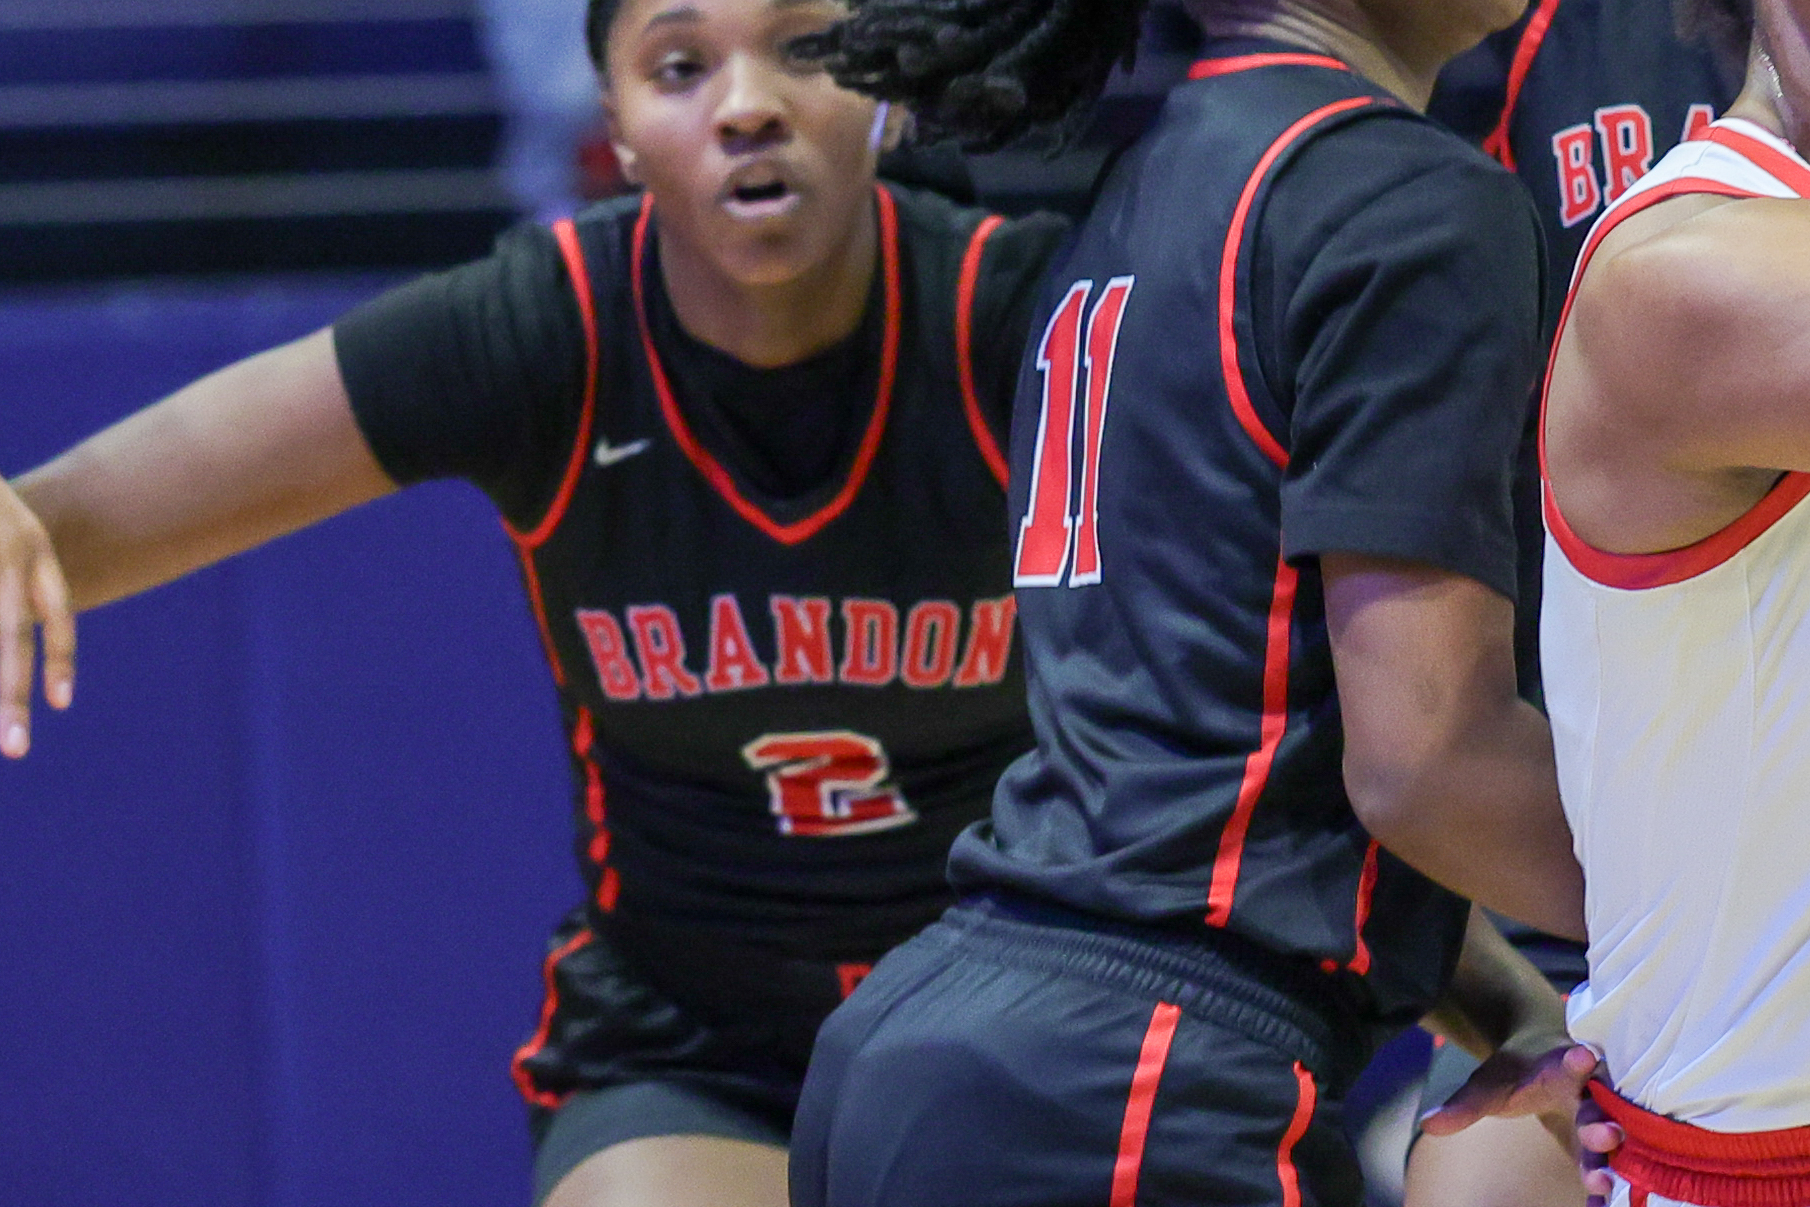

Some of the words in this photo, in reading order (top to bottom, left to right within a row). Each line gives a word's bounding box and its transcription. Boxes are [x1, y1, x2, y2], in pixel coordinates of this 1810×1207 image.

[1013, 274, 1135, 588] 11
[575, 593, 1017, 699] BRANDON
[741, 729, 918, 836] 2
